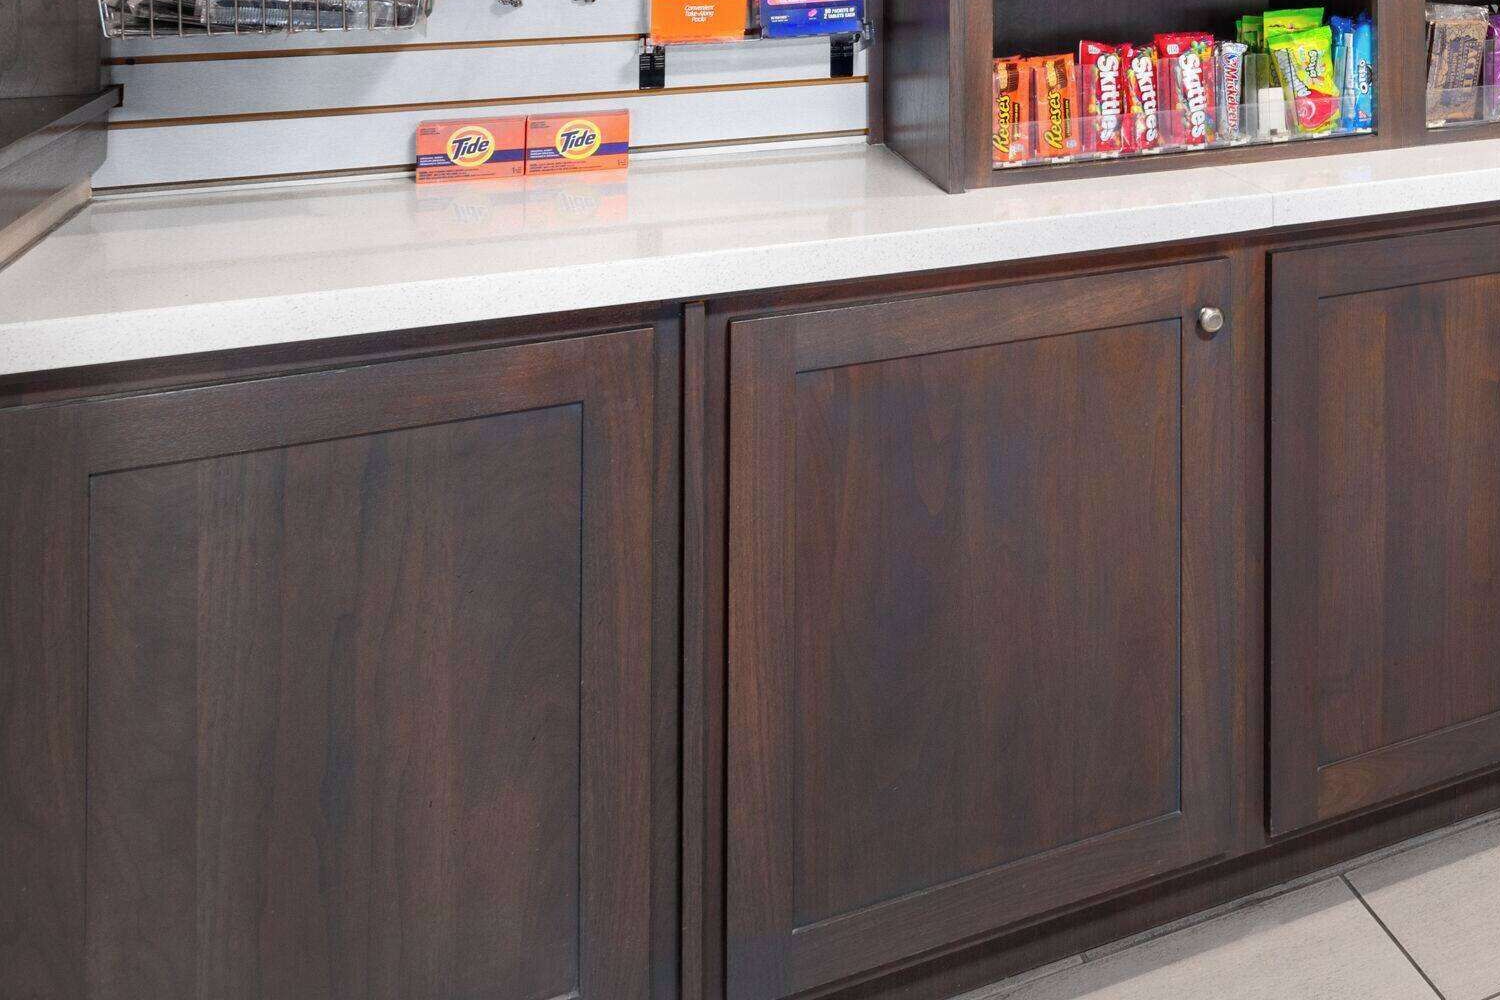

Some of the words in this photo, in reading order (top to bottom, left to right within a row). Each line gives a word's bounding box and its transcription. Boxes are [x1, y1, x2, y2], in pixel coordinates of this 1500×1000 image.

[1358, 59, 1368, 94] OREO
[1045, 90, 1062, 149] Reese's
[1224, 66, 1241, 134] Musketeers
[560, 129, 597, 152] Tide
[993, 95, 1011, 153] Reese's
[451, 136, 490, 160] Tide
